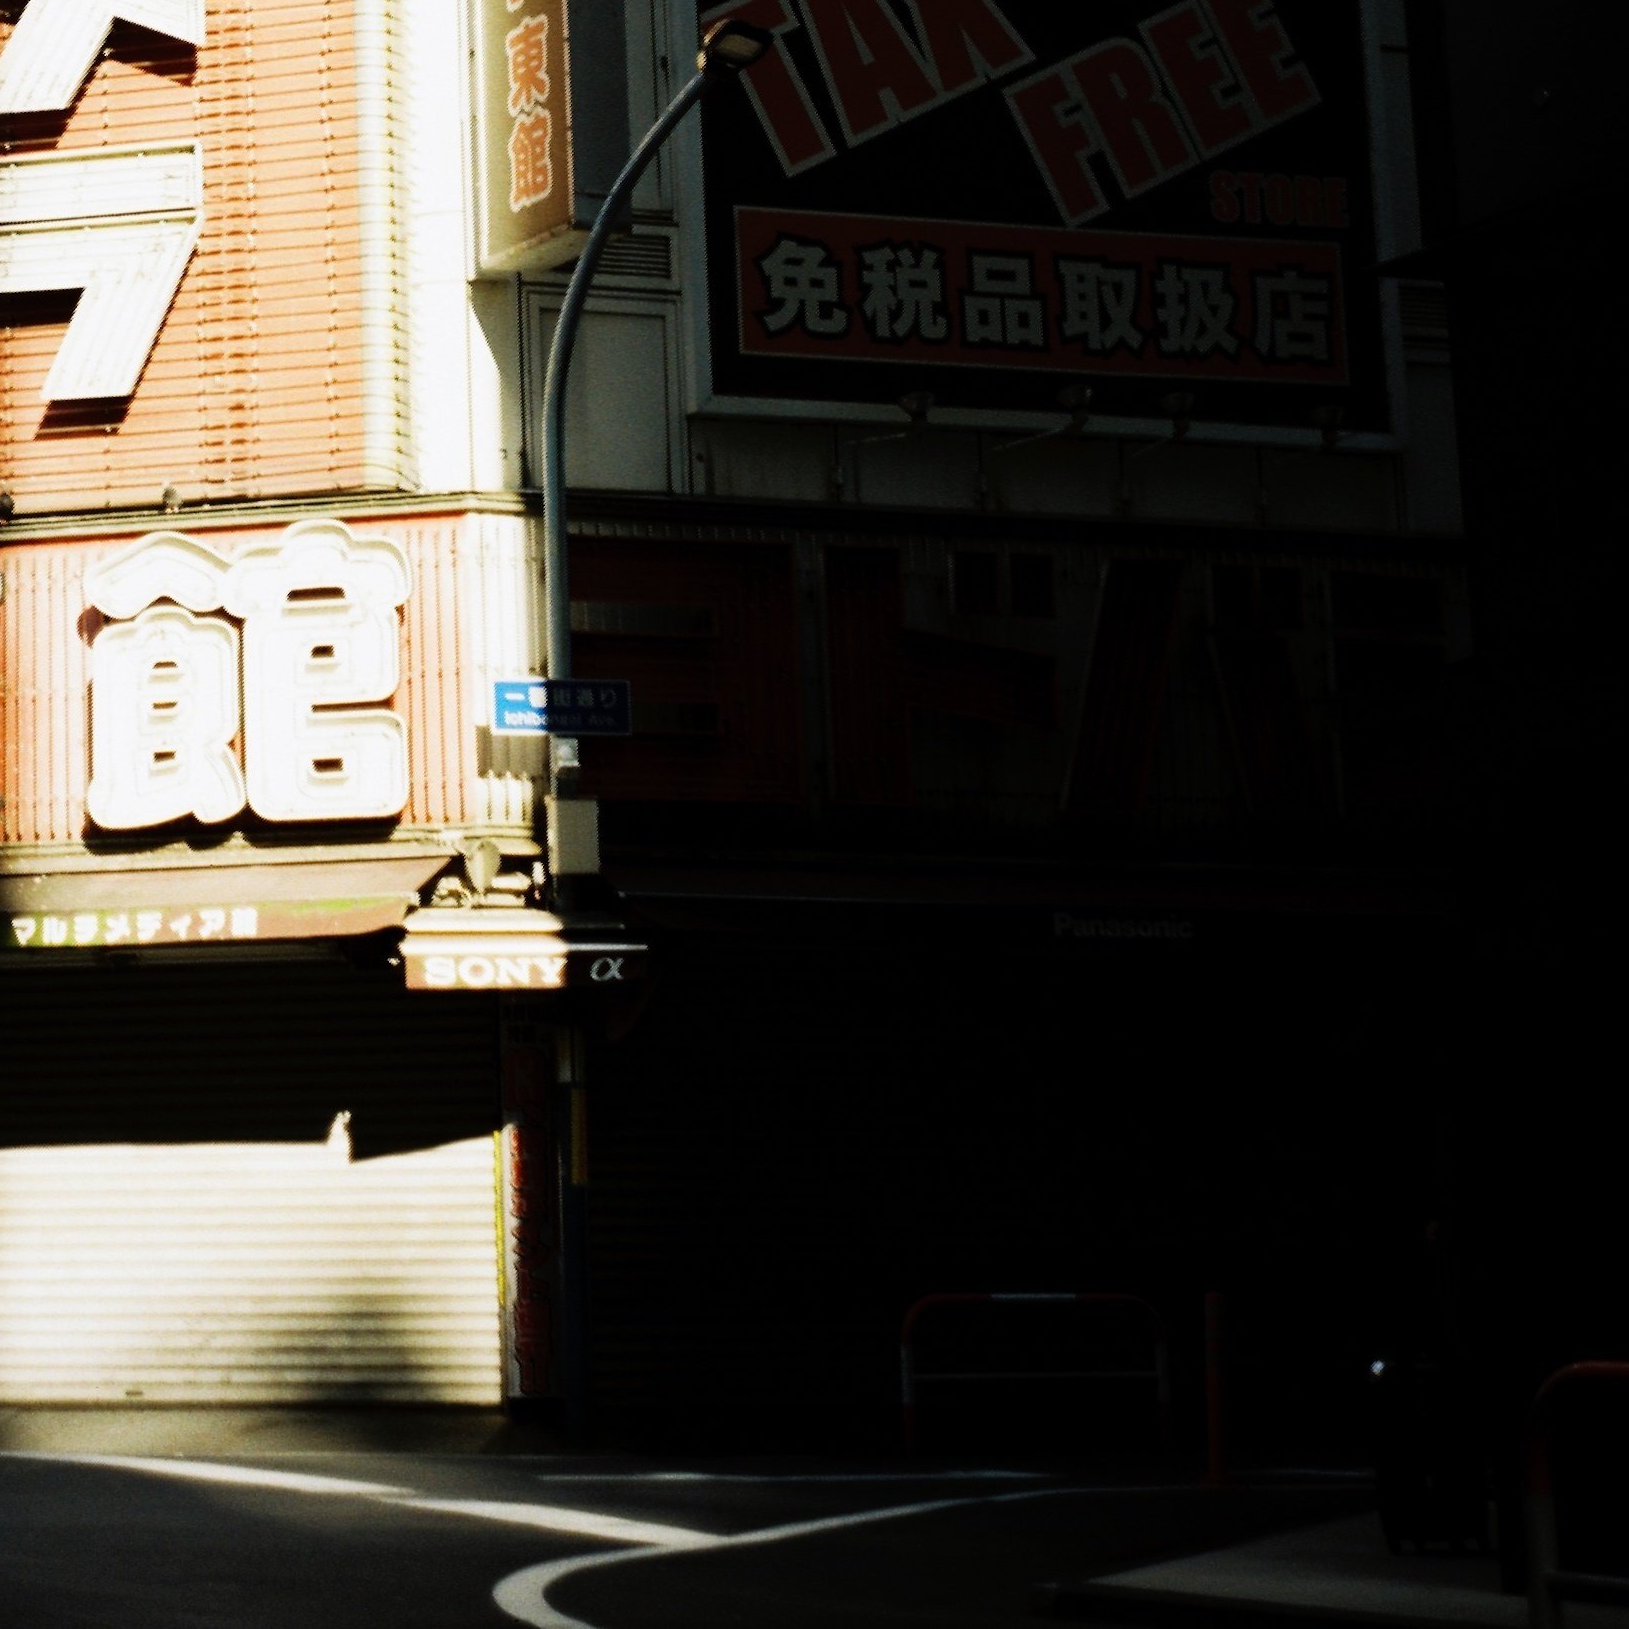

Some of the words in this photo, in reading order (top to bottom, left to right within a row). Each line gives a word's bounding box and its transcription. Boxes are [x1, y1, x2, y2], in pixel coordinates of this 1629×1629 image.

[1209, 170, 1351, 229] STORE
[754, 232, 1336, 366] 免税品取扱店
[1051, 909, 1196, 943] Panasonic
[424, 955, 568, 988] SONY
